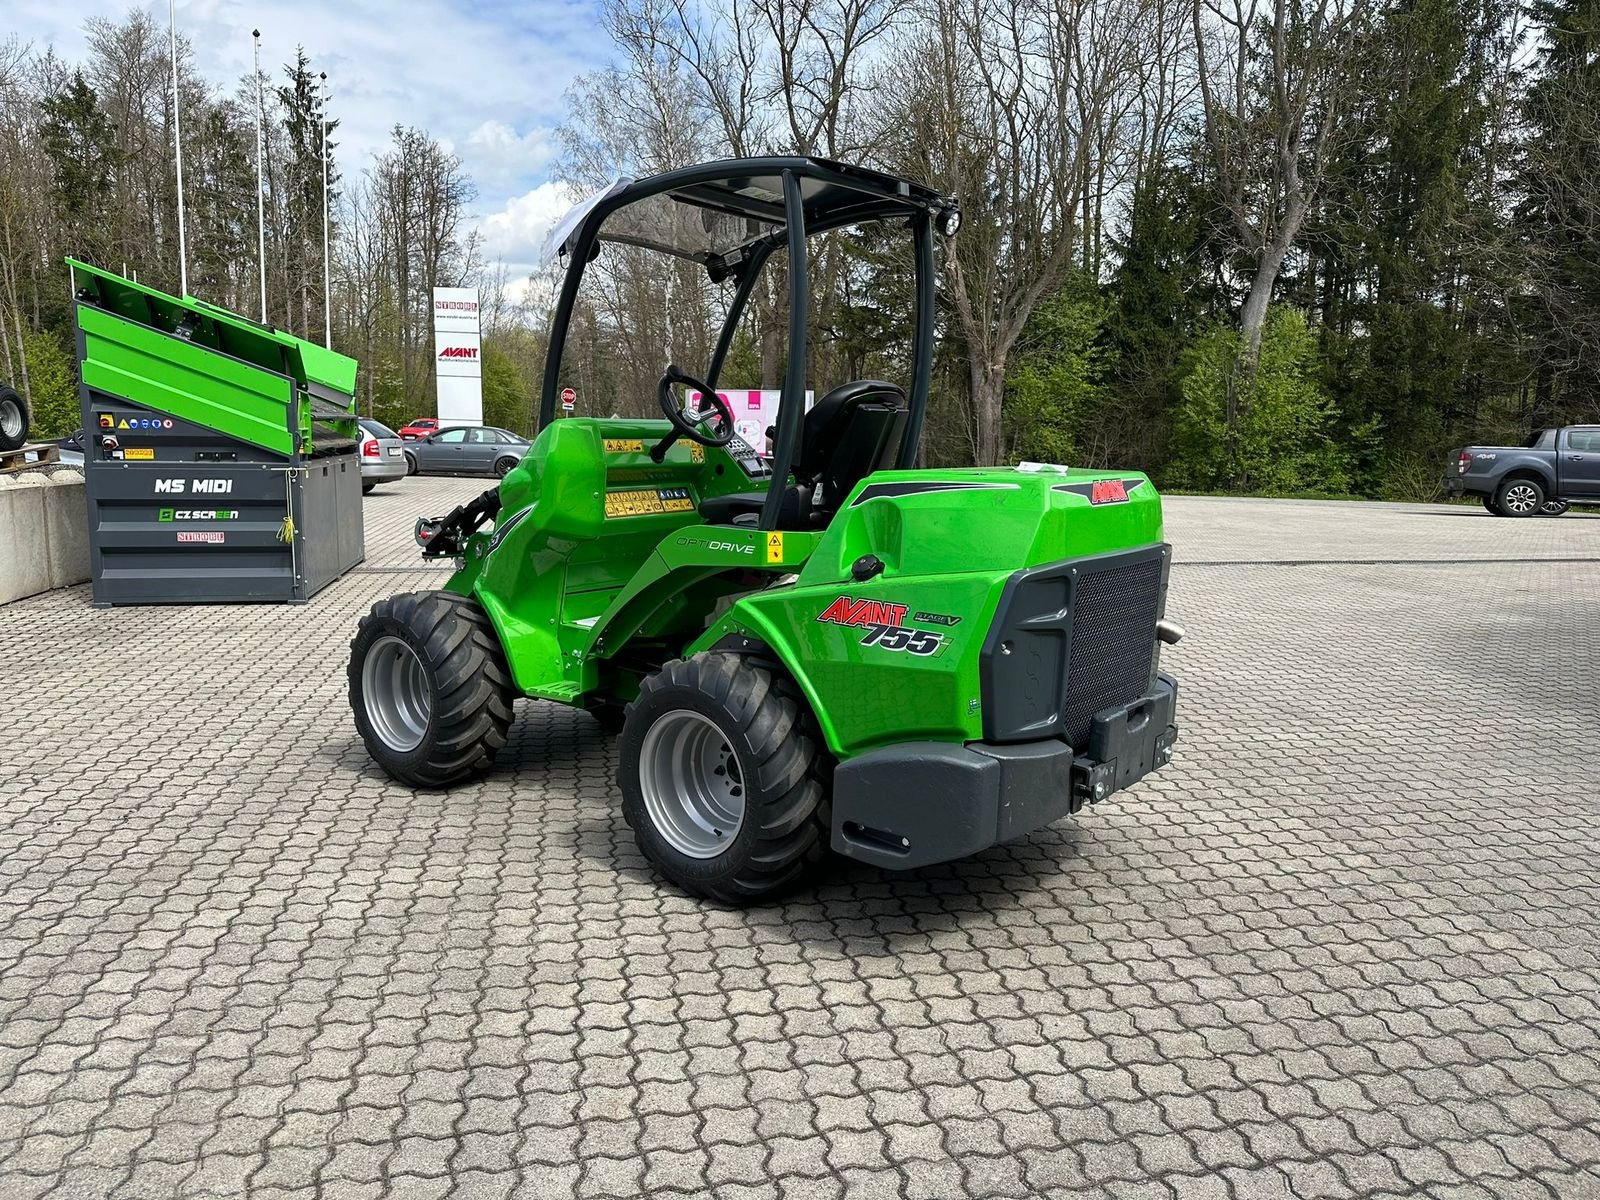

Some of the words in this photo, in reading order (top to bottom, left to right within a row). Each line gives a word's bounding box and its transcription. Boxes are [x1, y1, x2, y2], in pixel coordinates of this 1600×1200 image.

[438, 347, 478, 358] AVANT
[154, 479, 186, 493] MS
[191, 479, 233, 493] MIDI
[676, 537, 756, 554] OPTIDRIVE
[817, 595, 909, 628] AVANT
[946, 616, 961, 625] V
